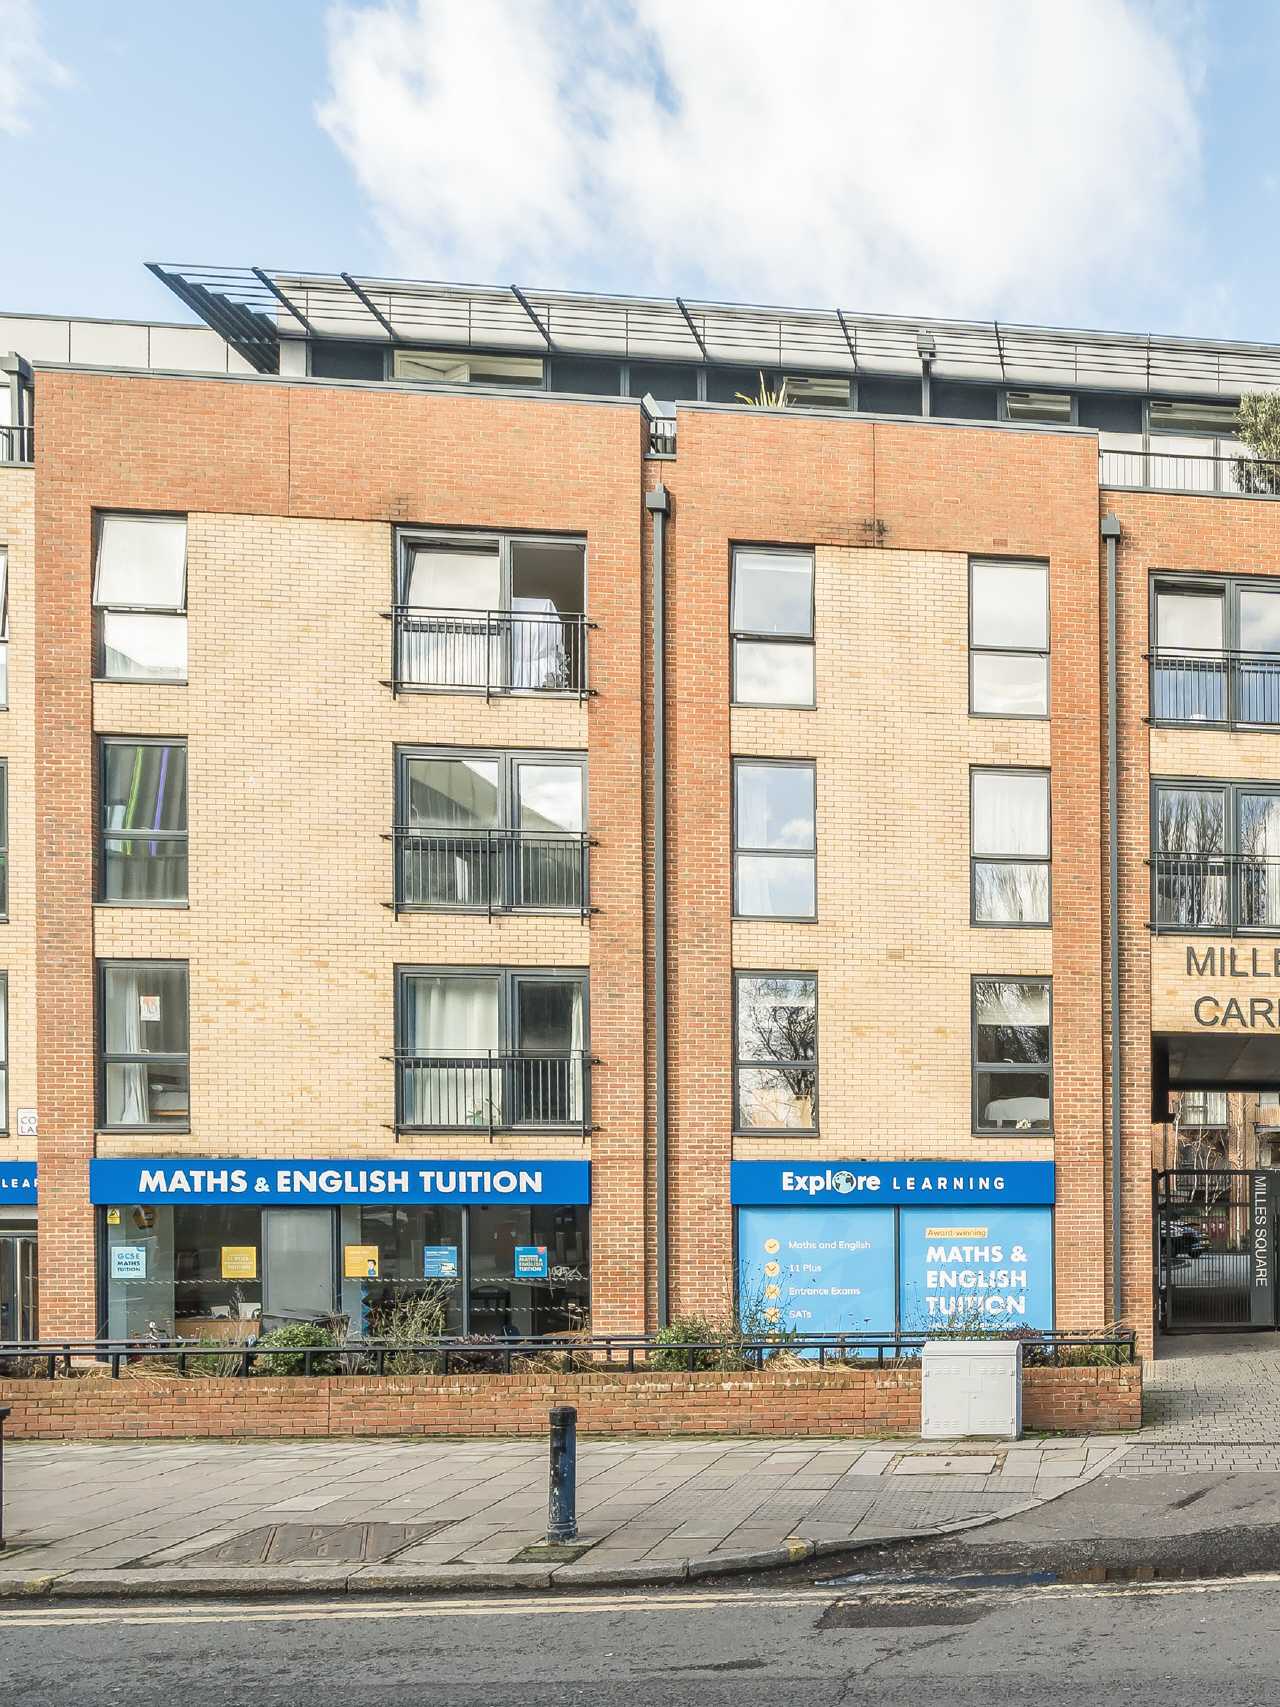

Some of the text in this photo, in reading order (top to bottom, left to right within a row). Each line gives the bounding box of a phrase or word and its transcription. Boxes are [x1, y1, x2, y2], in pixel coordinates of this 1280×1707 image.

[21, 1126, 38, 1134] LA
[139, 1169, 542, 1193] MATHS & ENGLISH TUITION
[782, 1170, 1006, 1195] Explore LEARNING
[927, 1229, 986, 1238] Award-winning
[1255, 1176, 1268, 1287] MILLES SQUARE
[788, 1241, 871, 1251] Maths and English
[926, 1246, 1028, 1263] MATHS &
[926, 1270, 1027, 1288] ENGLISH
[789, 1287, 861, 1296] Entrance Exams
[789, 1310, 812, 1318] SATs
[926, 1296, 1025, 1315] TUITION
